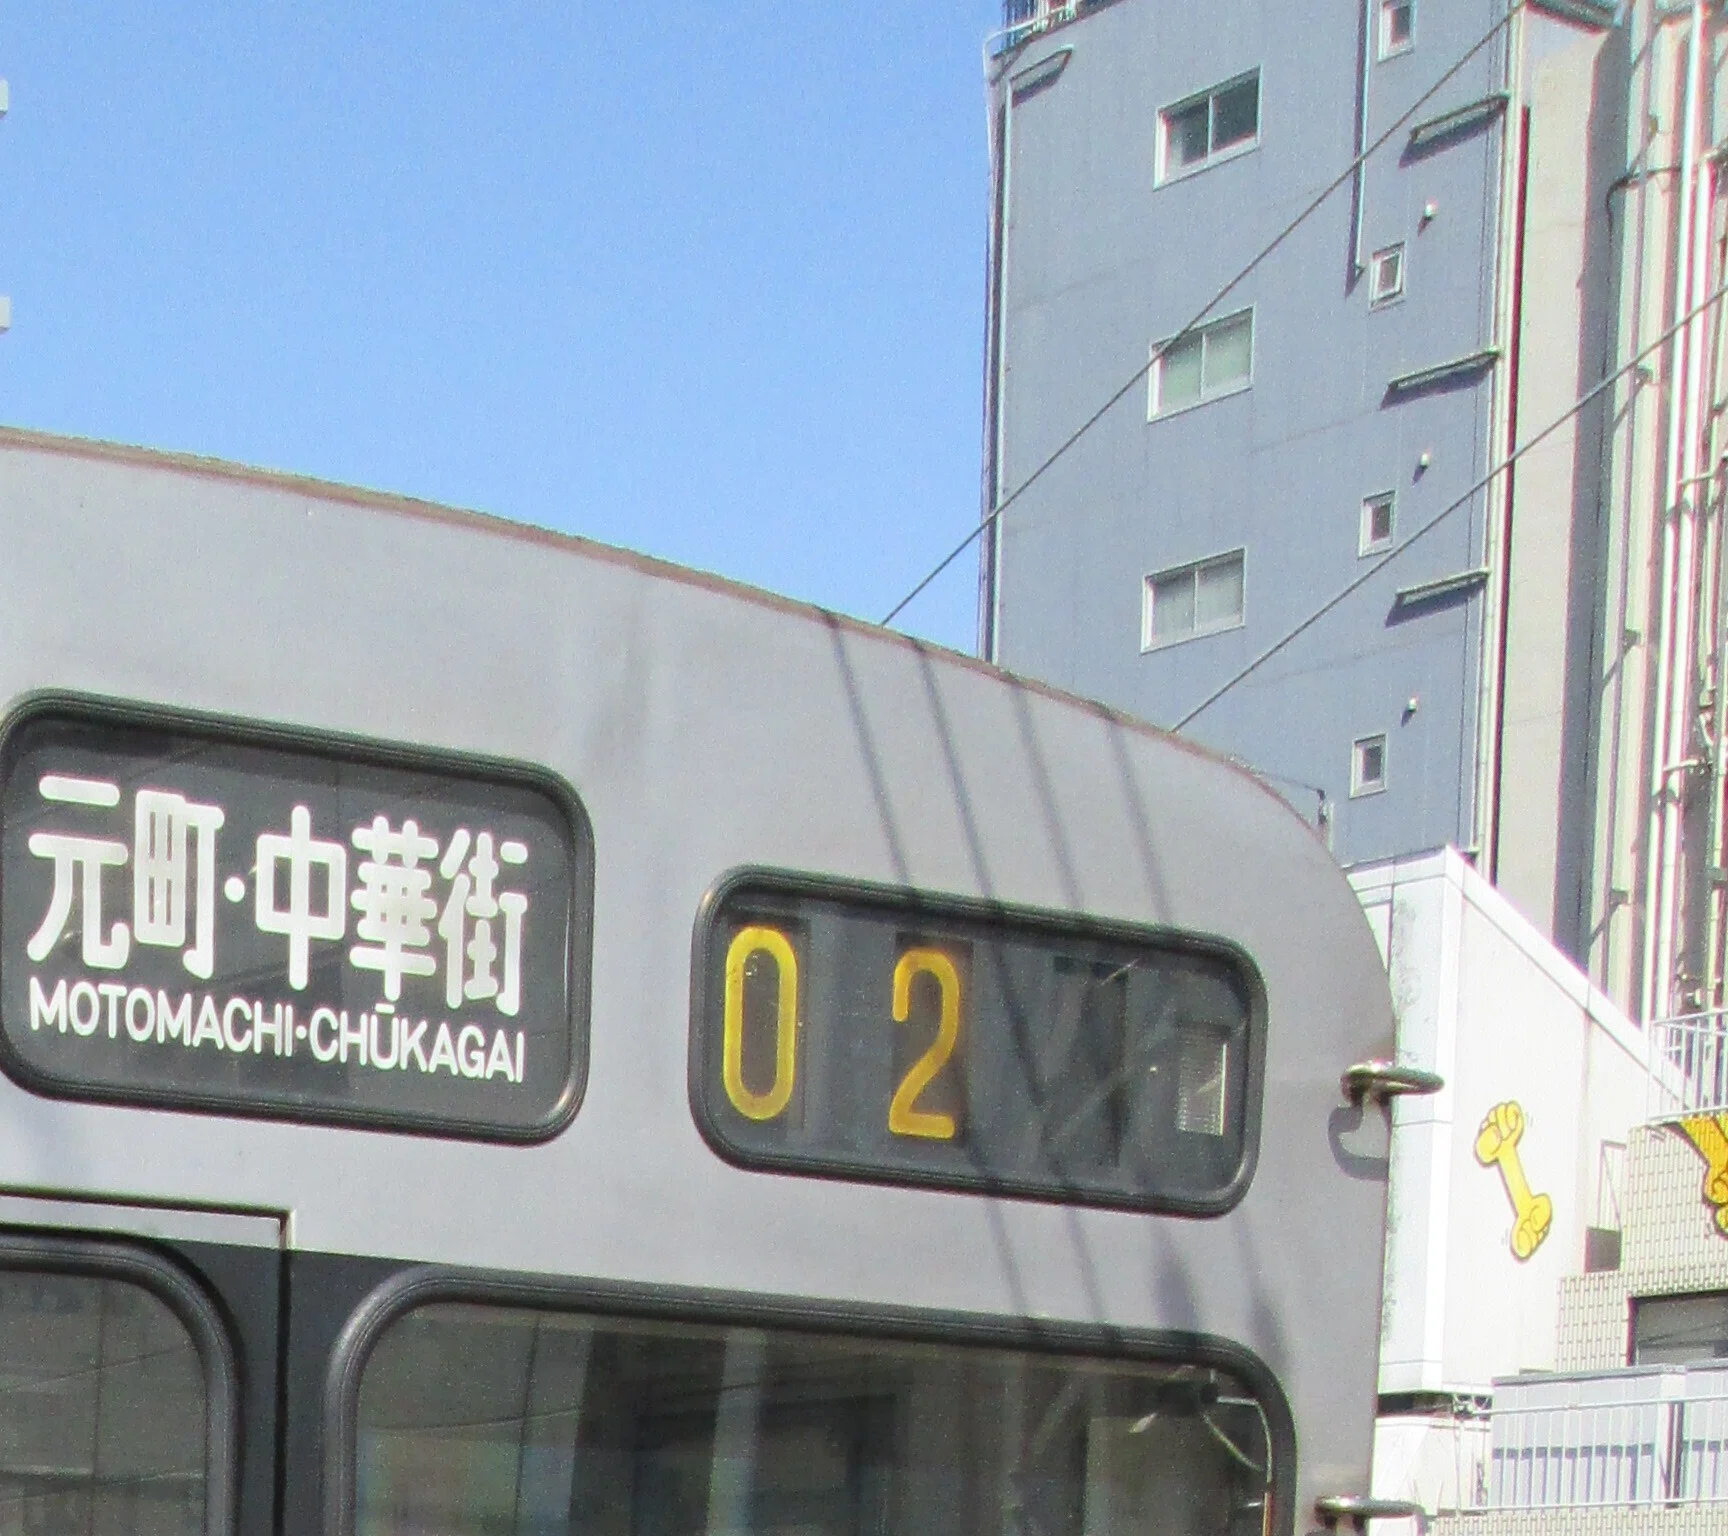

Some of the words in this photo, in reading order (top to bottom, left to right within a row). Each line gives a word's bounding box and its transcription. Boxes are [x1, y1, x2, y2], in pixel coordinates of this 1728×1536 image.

[26, 774, 529, 1016] 元町・中華街
